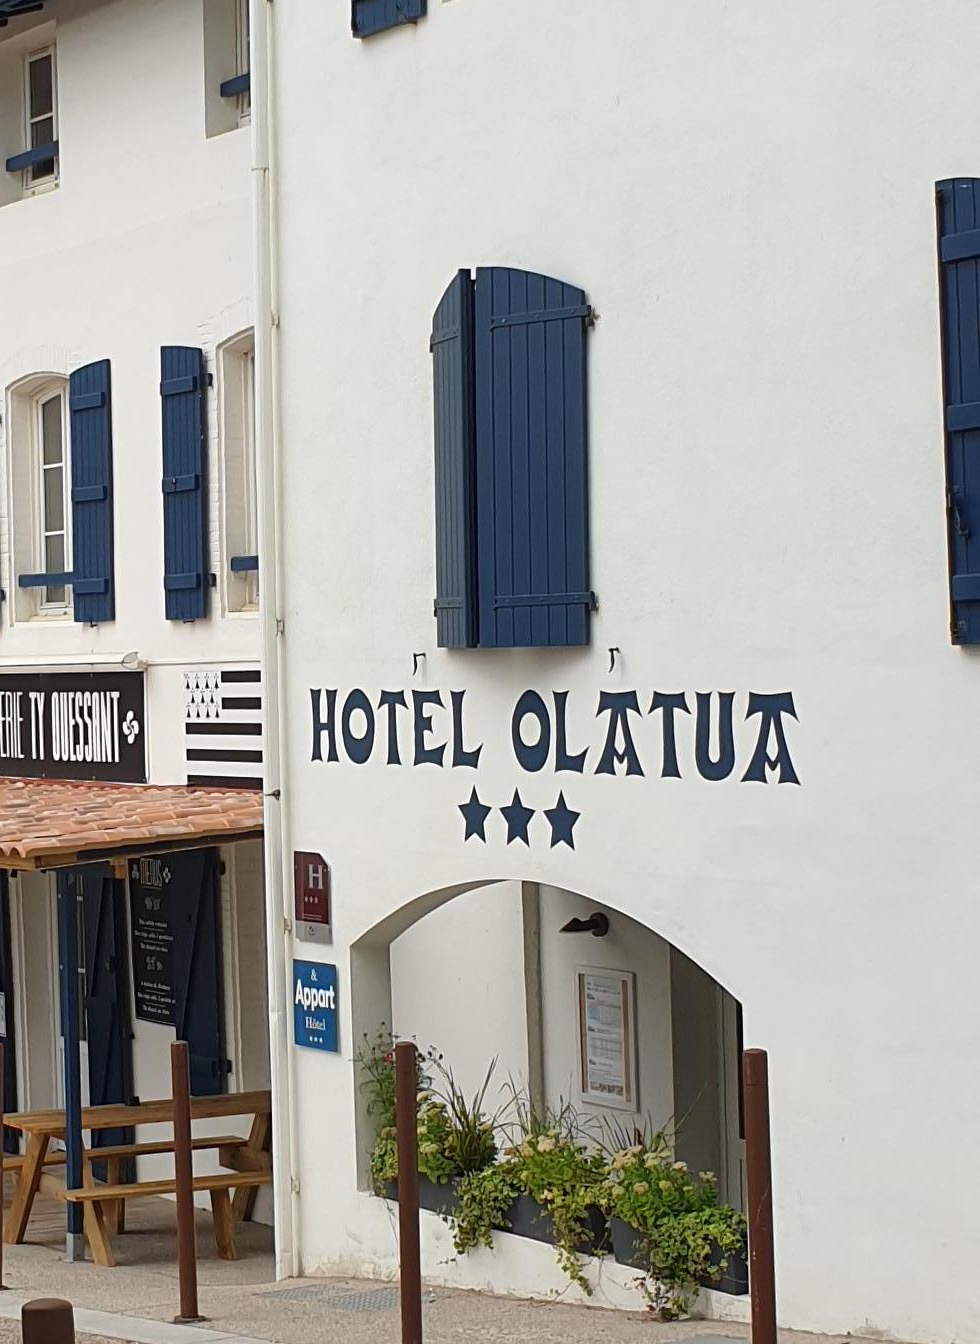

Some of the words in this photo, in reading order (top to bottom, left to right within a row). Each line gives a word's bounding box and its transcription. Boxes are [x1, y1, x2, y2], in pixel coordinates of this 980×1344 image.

[29, 691, 45, 760] TY
[51, 691, 120, 763] OUESSANT
[309, 687, 484, 770] HOTEL
[511, 688, 802, 786] OLATUA
[307, 863, 324, 890] H
[310, 968, 318, 982] &
[295, 978, 336, 1011] Appart
[305, 1016, 326, 1031] Hôtel
